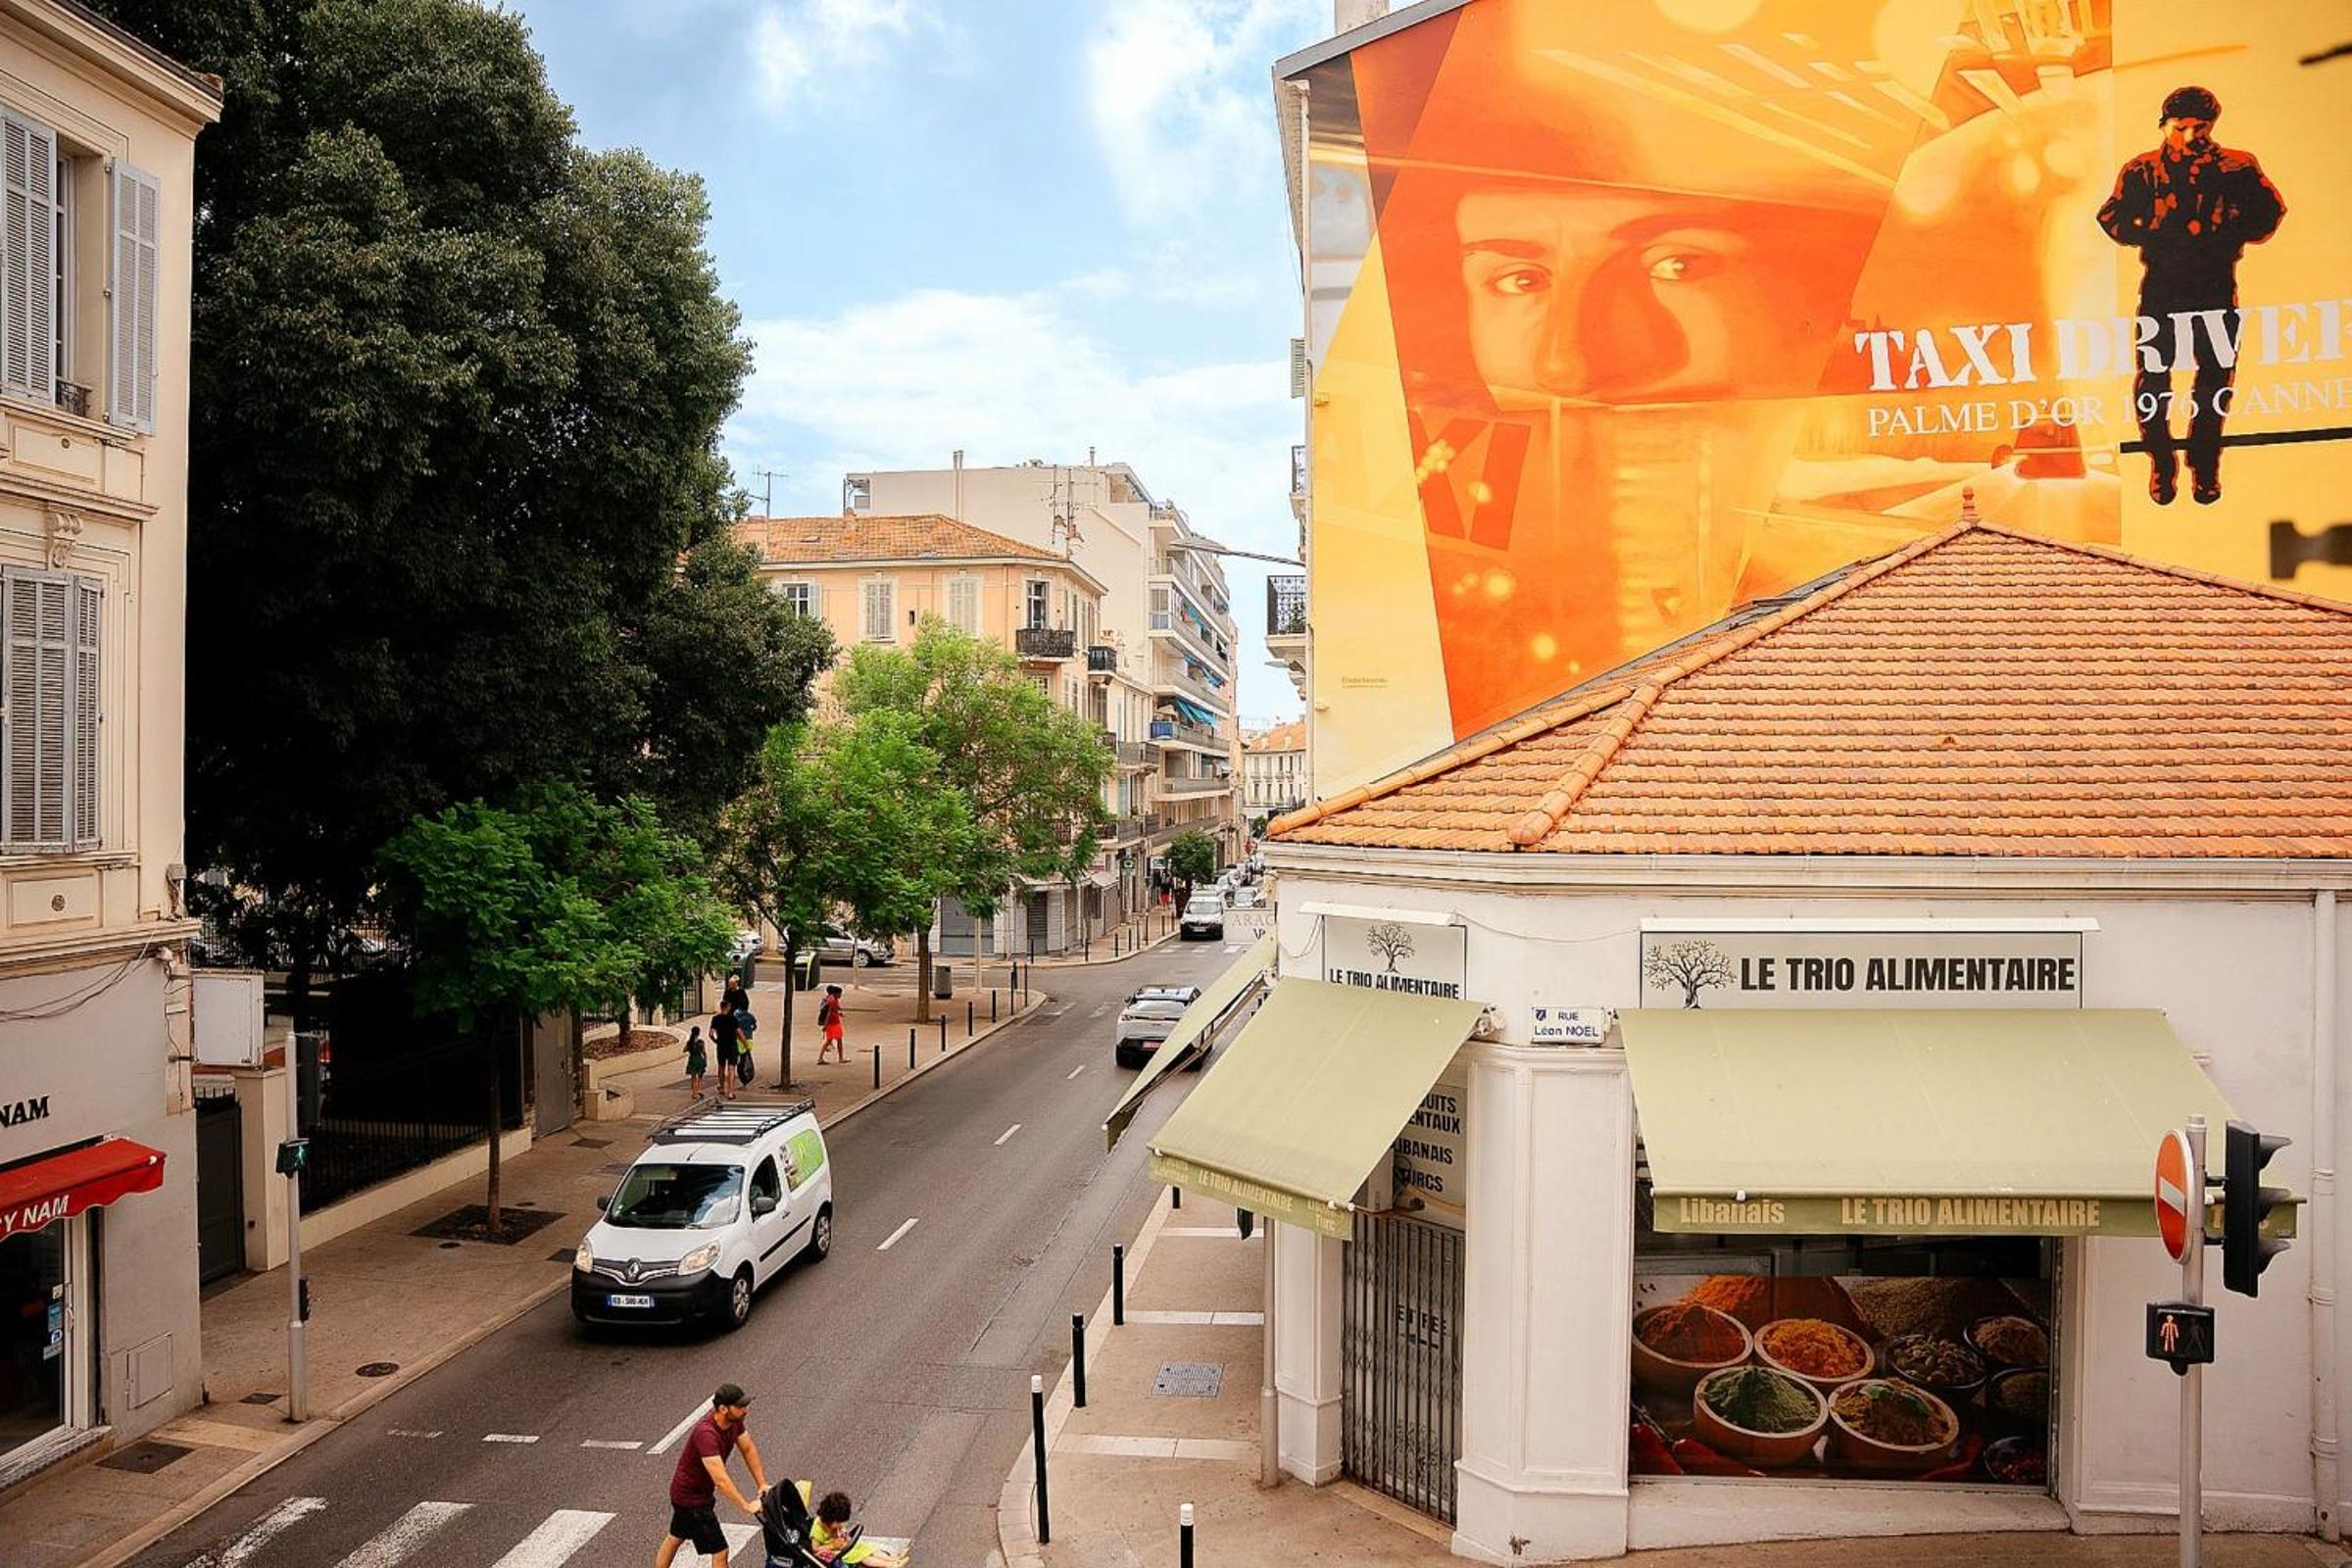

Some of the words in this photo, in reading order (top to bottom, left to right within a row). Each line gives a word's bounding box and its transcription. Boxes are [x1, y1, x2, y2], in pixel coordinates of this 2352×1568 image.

[1854, 322, 2037, 391] TAXI
[1869, 402, 1999, 437] PALME
[2122, 390, 2200, 423] 1976
[1330, 968, 1343, 984] LE
[1347, 970, 1372, 989] TRIO
[1376, 975, 1459, 1000] ALIMENTAIRE
[1740, 957, 1776, 991] LE
[1786, 957, 1855, 992] TRIO
[1865, 957, 2075, 991] ALIMENTAIRE
[1558, 1011, 1579, 1020] RUE
[1199, 1169, 1208, 1186] LE
[1210, 1172, 1231, 1193] TRIO
[1231, 1179, 1294, 1212] ALIMENTAIRE
[23, 1194, 70, 1227] NAM
[1680, 1198, 1786, 1224] Libanais
[1842, 1197, 1867, 1224] LE
[1873, 1198, 1931, 1225] TRIO
[1937, 1199, 2101, 1226] ALIMENTAIRE
